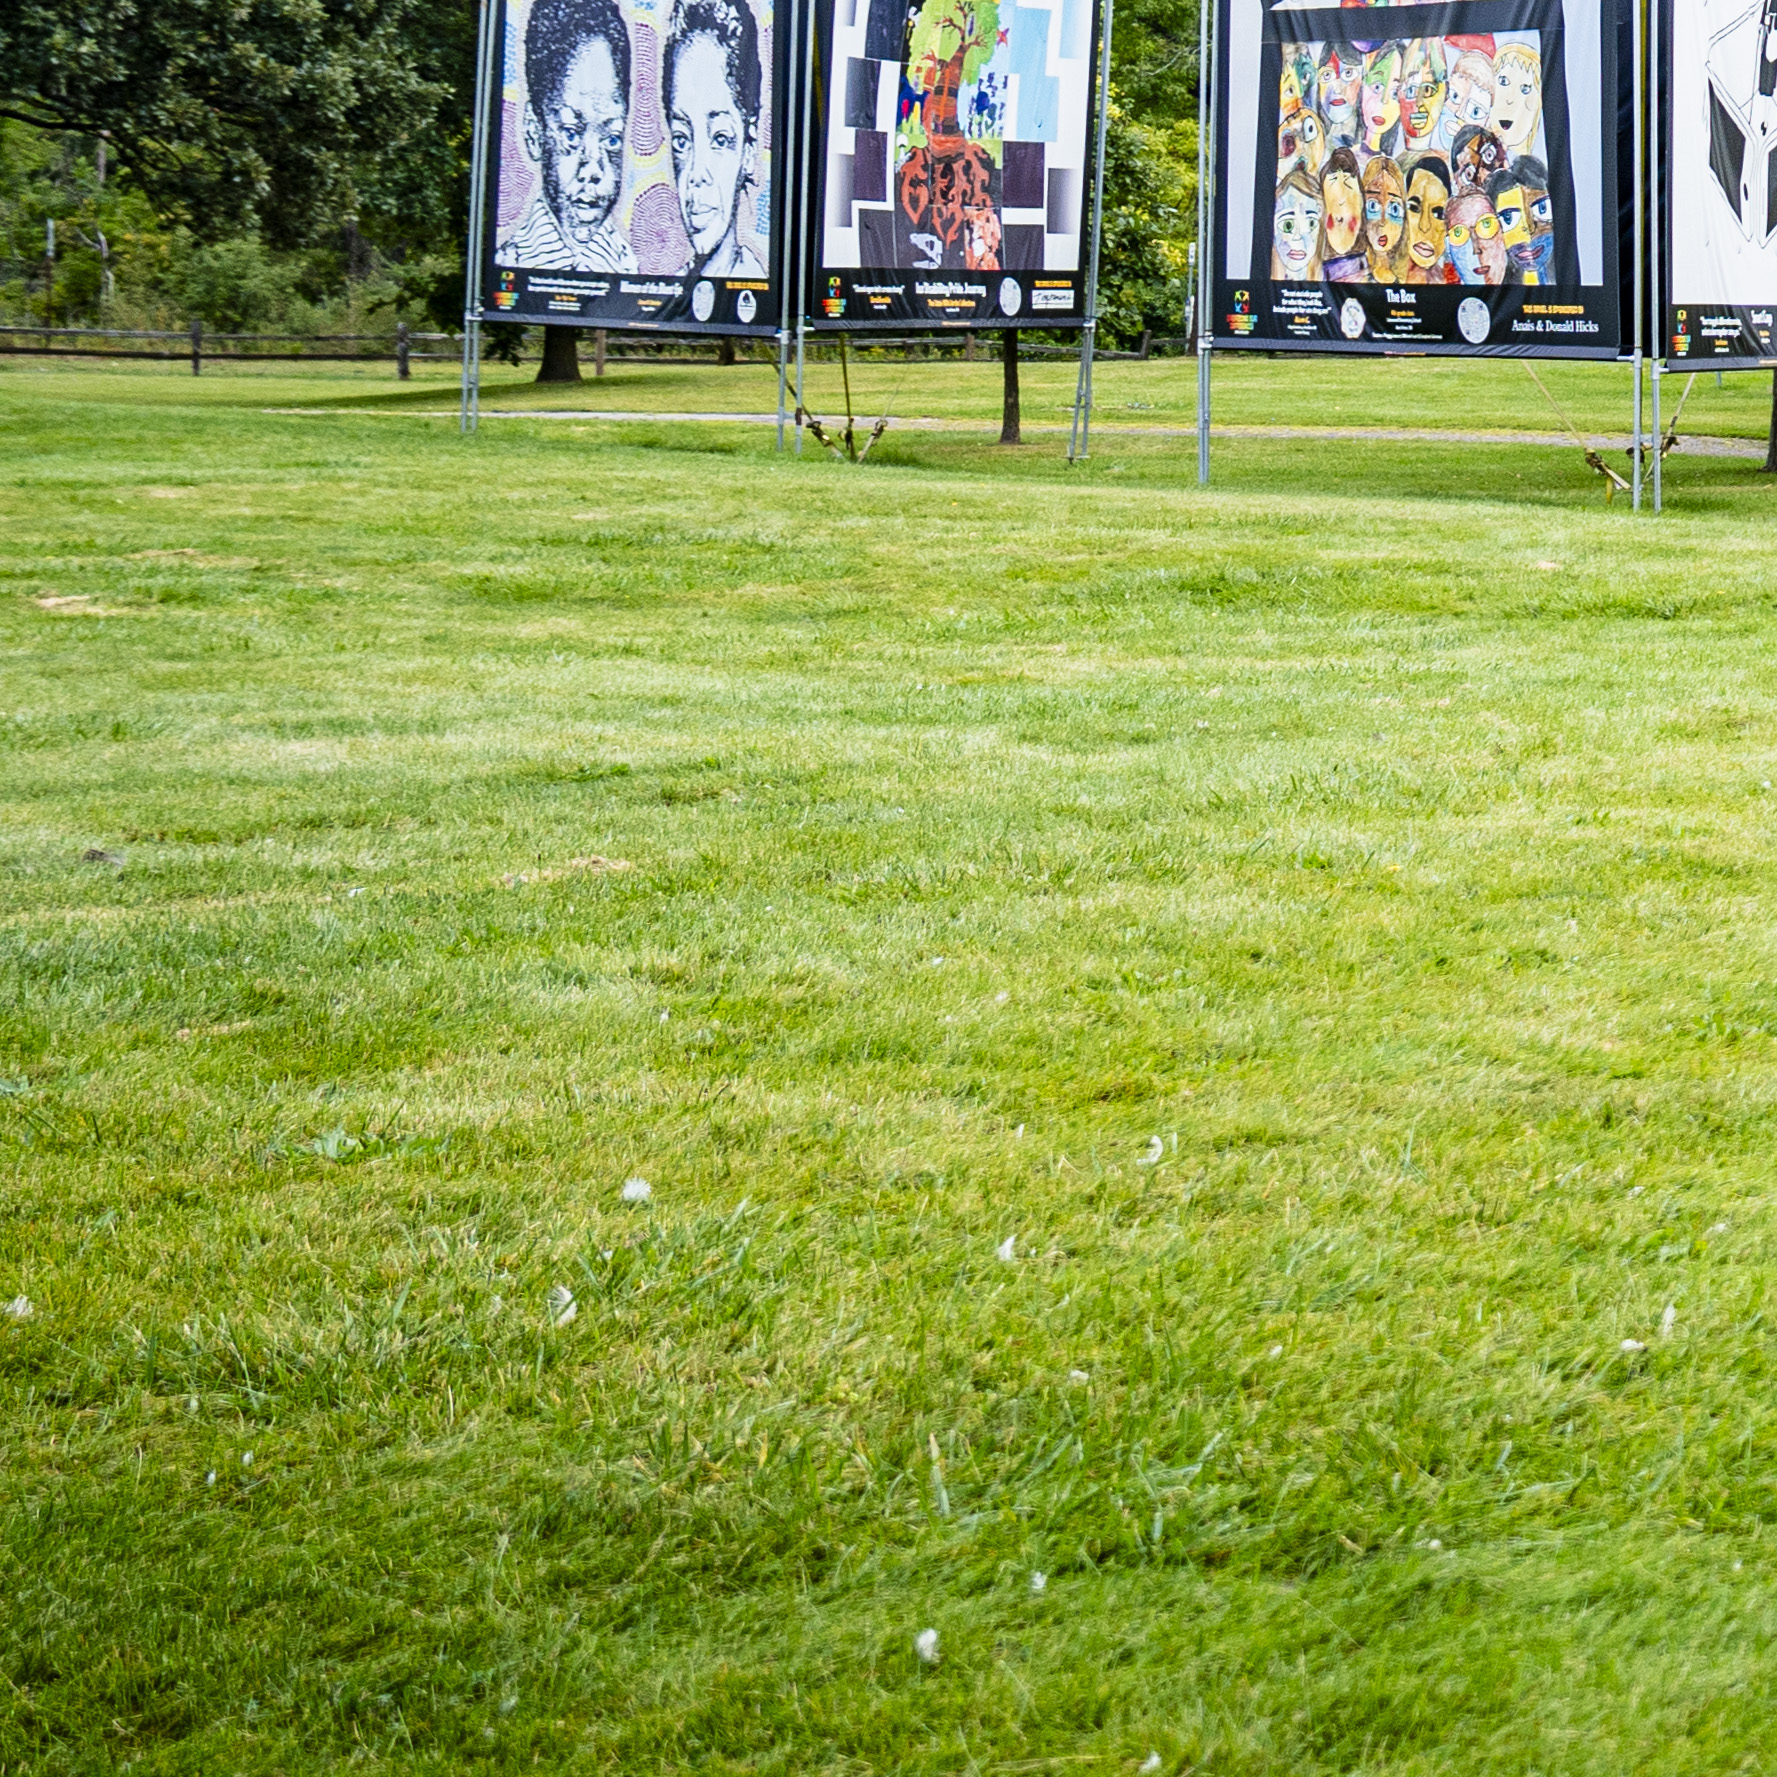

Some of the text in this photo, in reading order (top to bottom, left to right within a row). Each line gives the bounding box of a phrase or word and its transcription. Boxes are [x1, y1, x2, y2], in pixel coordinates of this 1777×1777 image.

[1385, 289, 1416, 303] The Box
[1536, 320, 1544, 332] &
[1545, 320, 1573, 332] Donald
[1575, 320, 1599, 332] Hicks
